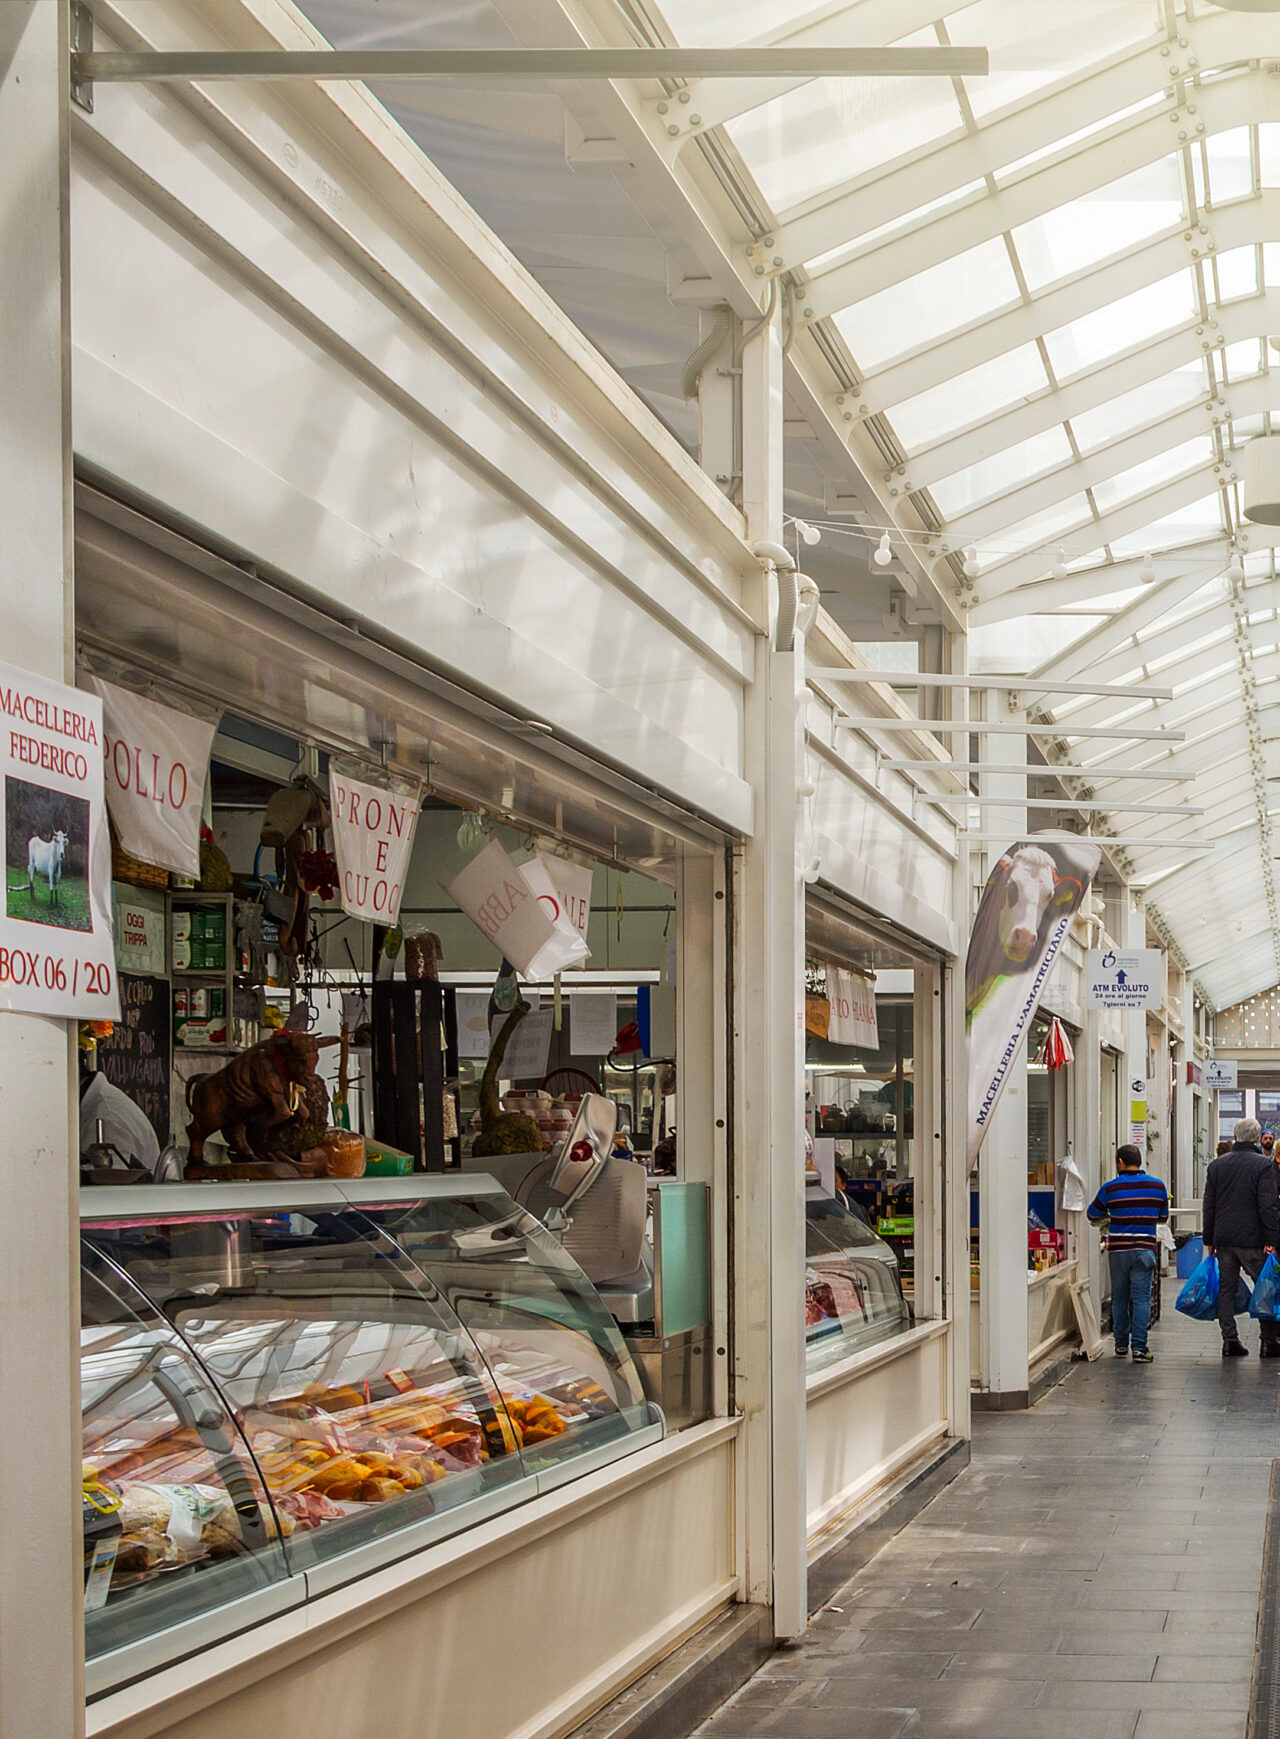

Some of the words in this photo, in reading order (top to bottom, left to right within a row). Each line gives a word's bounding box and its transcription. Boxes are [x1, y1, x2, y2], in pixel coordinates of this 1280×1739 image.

[0, 687, 98, 746] MACELLERIA
[9, 731, 87, 780] FEDERICO
[375, 840, 389, 872] E
[123, 931, 148, 947] TRIPPA
[126, 912, 145, 928] OGGI
[0, 948, 40, 987] BOX
[44, 956, 66, 990] 06
[84, 961, 110, 996] 20
[1093, 984, 1109, 992] ATM
[1112, 984, 1149, 992] EVOLUTO
[976, 1032, 1020, 1126] MACELLERIA
[1016, 917, 1069, 1030] L'AMATRICIANO
